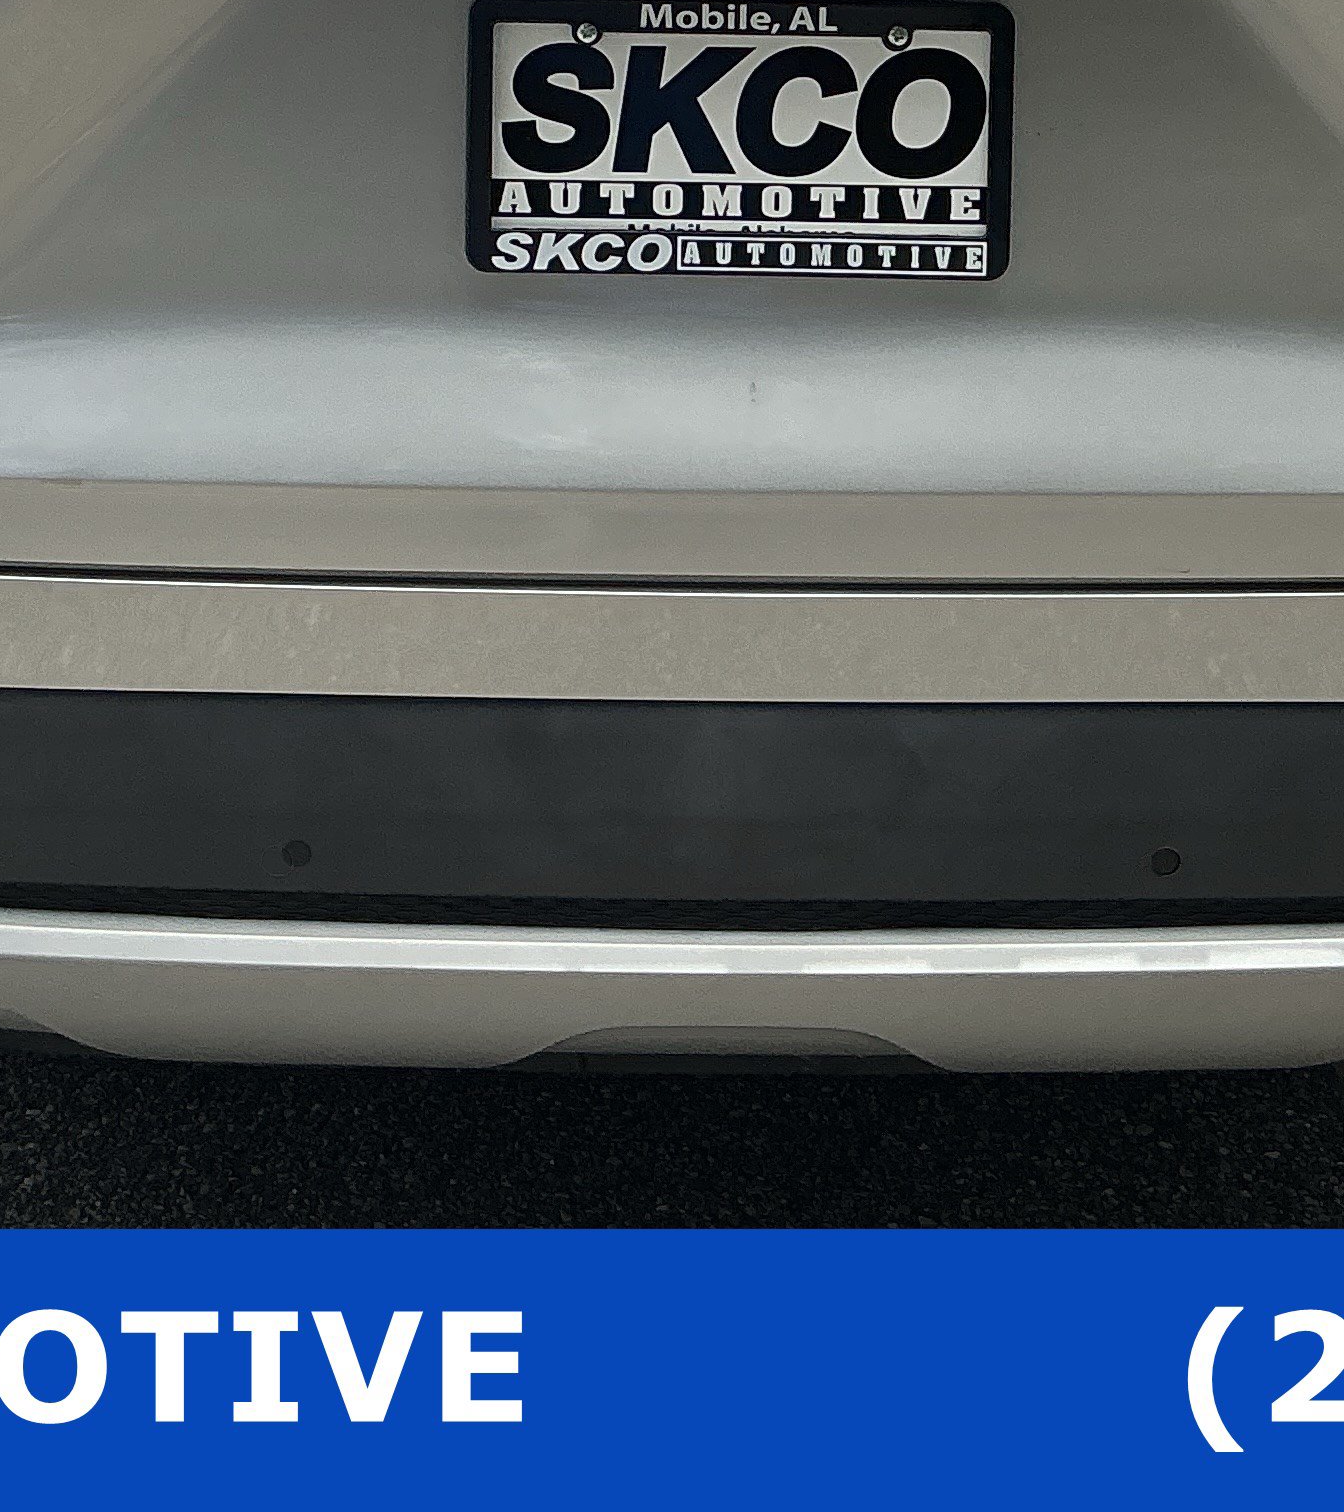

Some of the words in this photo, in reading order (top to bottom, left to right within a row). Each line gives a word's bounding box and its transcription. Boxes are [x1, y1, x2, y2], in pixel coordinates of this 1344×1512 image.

[639, 3, 782, 35] Mobile,
[789, 6, 839, 33] AL
[501, 42, 988, 180] SKCO
[498, 181, 982, 221] AUTOMOTIVE
[491, 232, 674, 272] SKCO
[682, 241, 985, 271] AUTOMOTIVE
